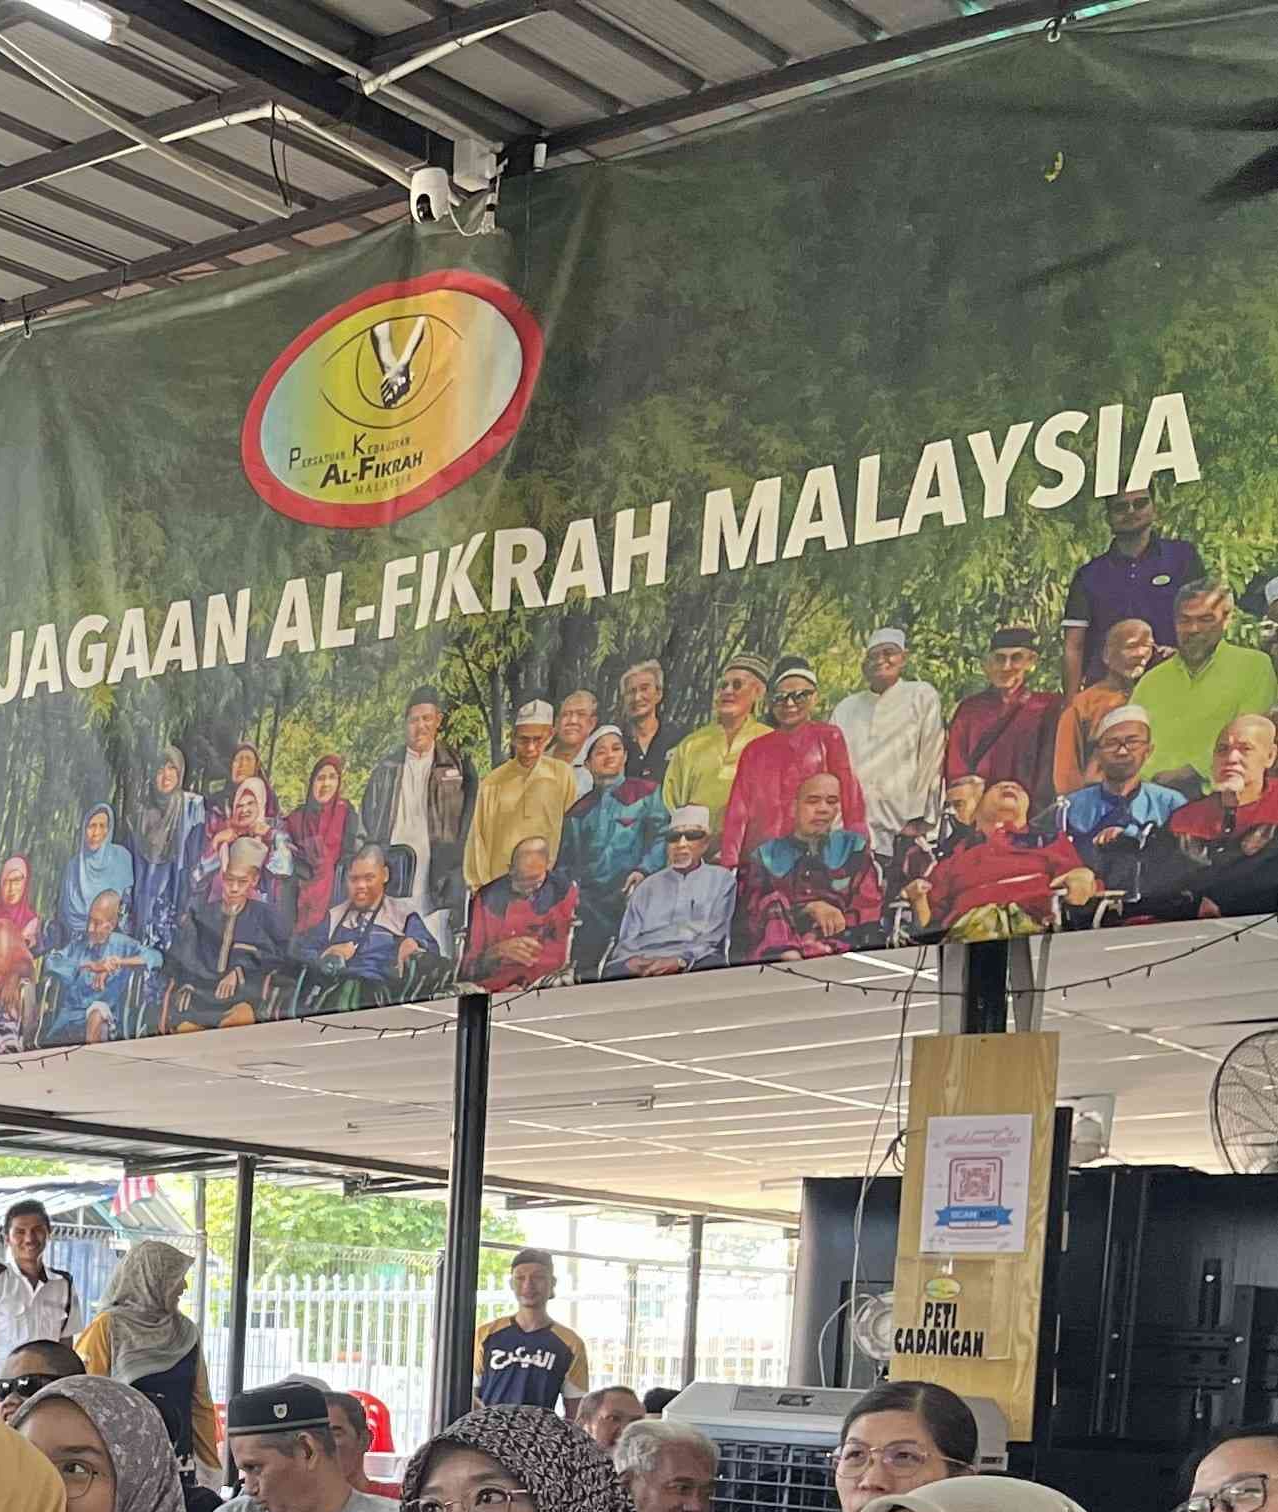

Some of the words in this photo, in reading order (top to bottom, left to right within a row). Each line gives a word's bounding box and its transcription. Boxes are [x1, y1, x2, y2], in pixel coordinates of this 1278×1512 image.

[319, 450, 423, 489] AL-FIKRAH
[265, 501, 671, 660] AL-FIKRAH
[700, 392, 1202, 577] MALAYSIA
[924, 1302, 957, 1329] PETI
[894, 1328, 984, 1358] CADANGAN
